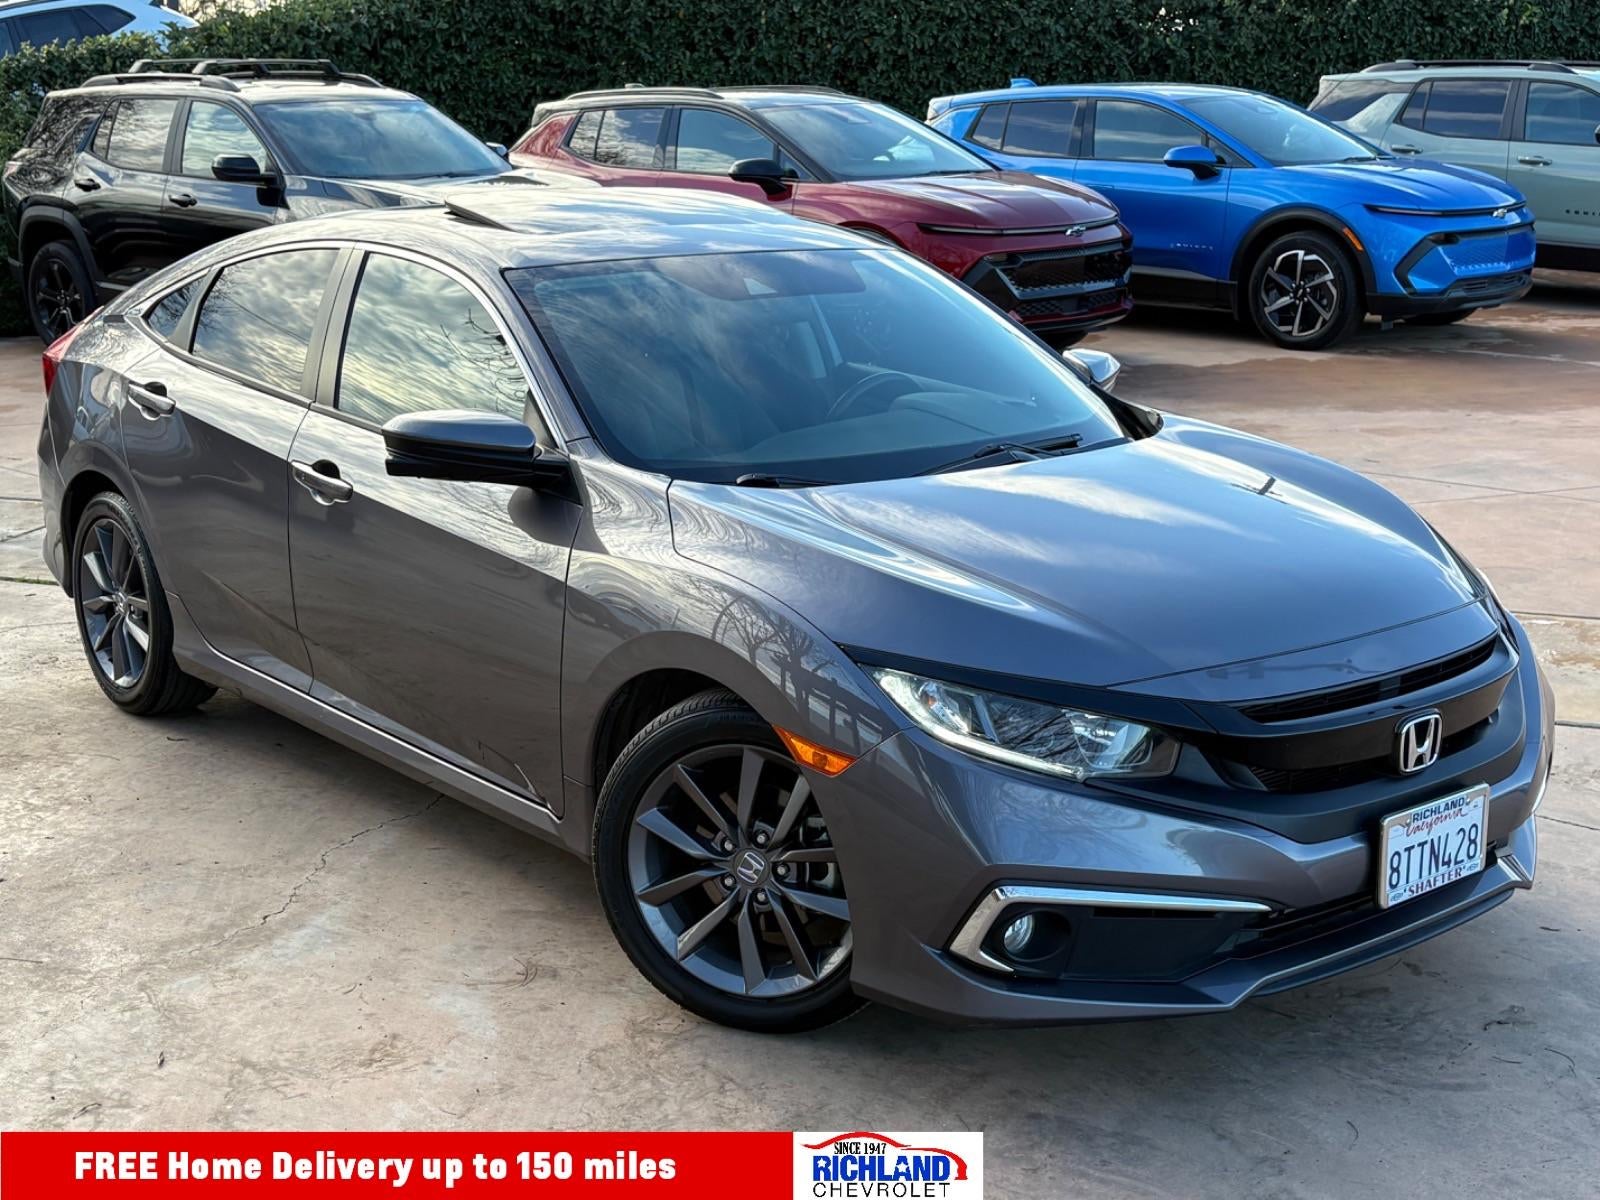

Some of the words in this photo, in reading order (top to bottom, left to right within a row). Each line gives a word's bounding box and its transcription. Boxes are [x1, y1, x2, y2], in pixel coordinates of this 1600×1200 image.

[1412, 797, 1465, 823] RICHLAND
[1388, 823, 1479, 890] 8TTN428
[1408, 867, 1462, 896] SHAFTER
